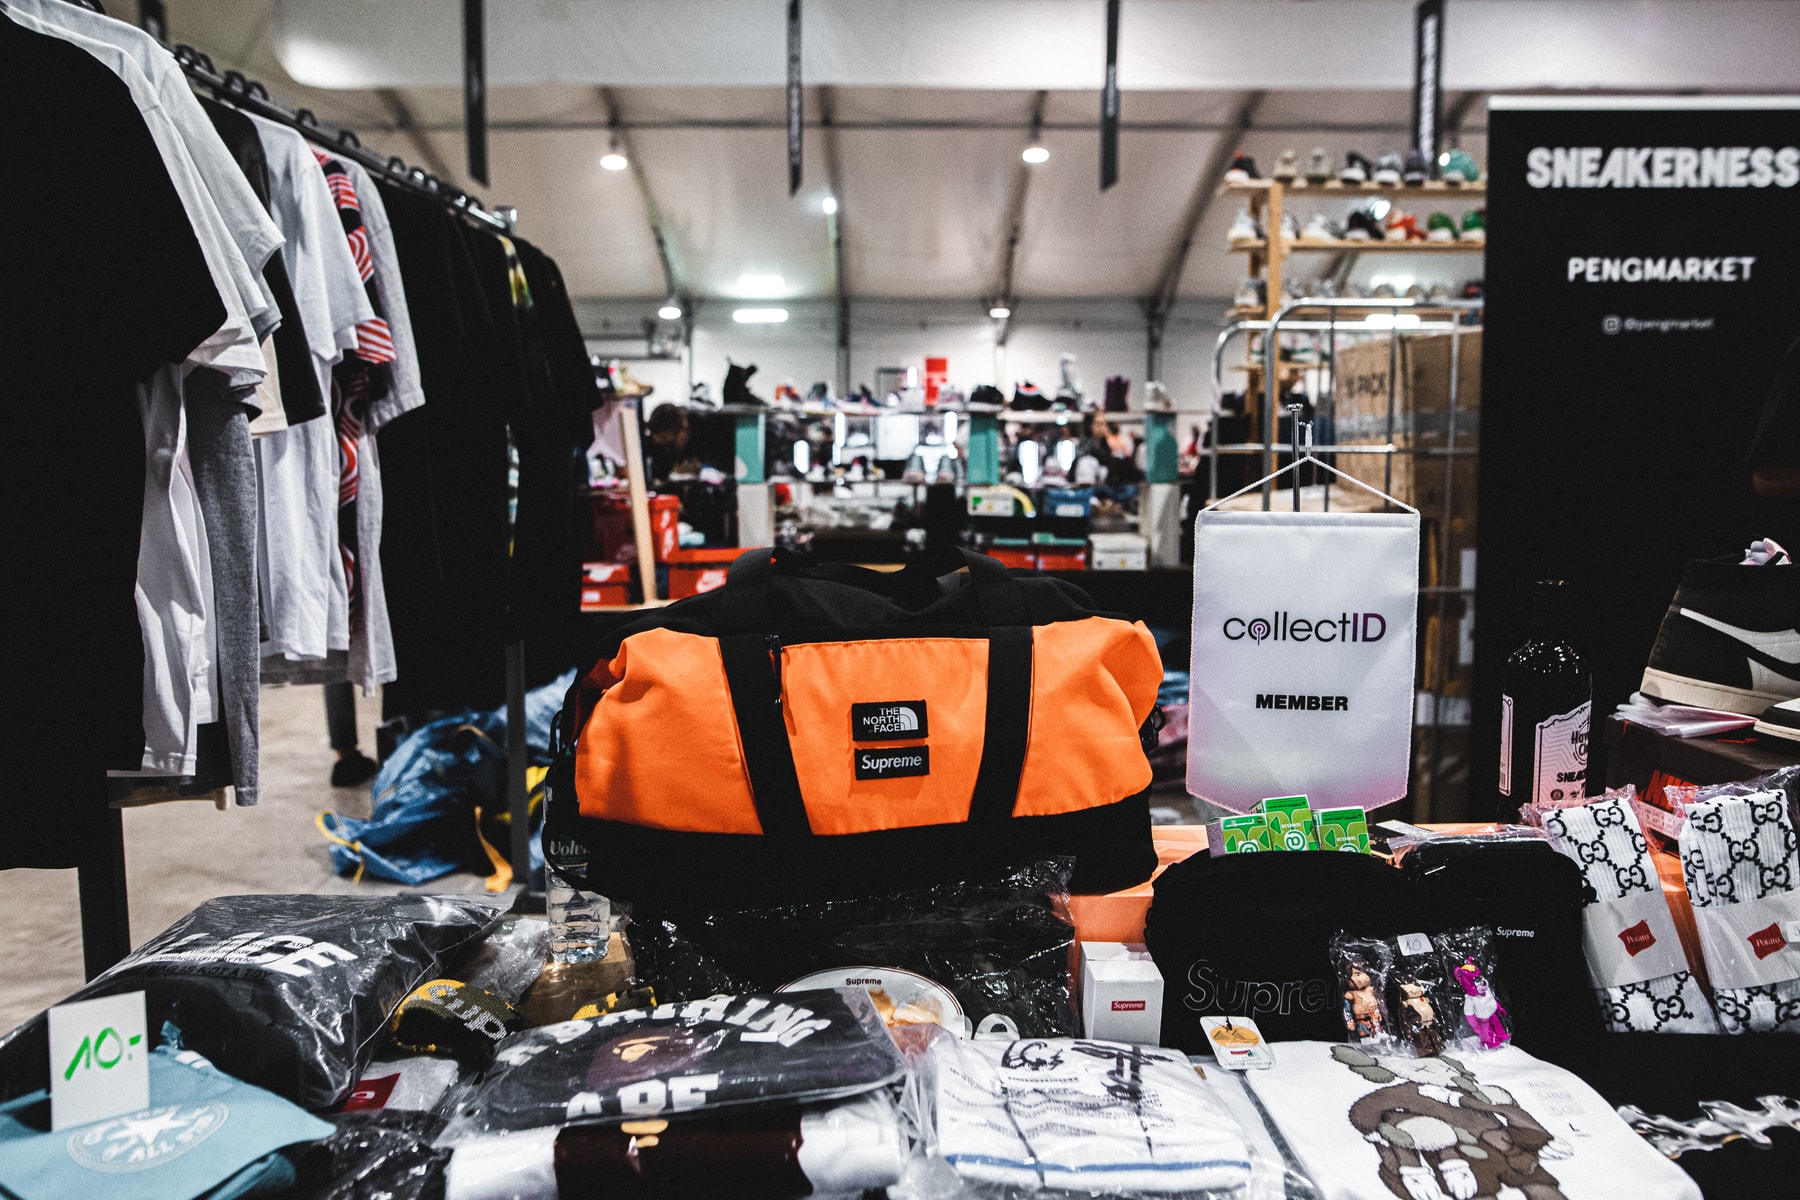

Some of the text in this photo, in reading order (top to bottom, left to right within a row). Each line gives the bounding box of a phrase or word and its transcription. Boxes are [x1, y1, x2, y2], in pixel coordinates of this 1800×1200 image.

[1526, 147, 1800, 188] SNEAKERNESS
[1567, 256, 1757, 282] PENGMARKET
[1223, 611, 1387, 645] collectID
[1256, 694, 1348, 711] MEMBER
[879, 707, 900, 715] THE
[863, 715, 900, 725] NORTH
[873, 723, 901, 733] FACE
[861, 754, 922, 774] Supreme
[1496, 926, 1536, 938] Supreme
[1405, 939, 1422, 951] 10
[1626, 934, 1650, 945] Potato
[1756, 937, 1781, 948] Potato
[197, 966, 228, 976] NOT
[243, 968, 275, 980] TOY
[845, 977, 882, 986] Supreme
[1113, 1001, 1144, 1010] Supreme
